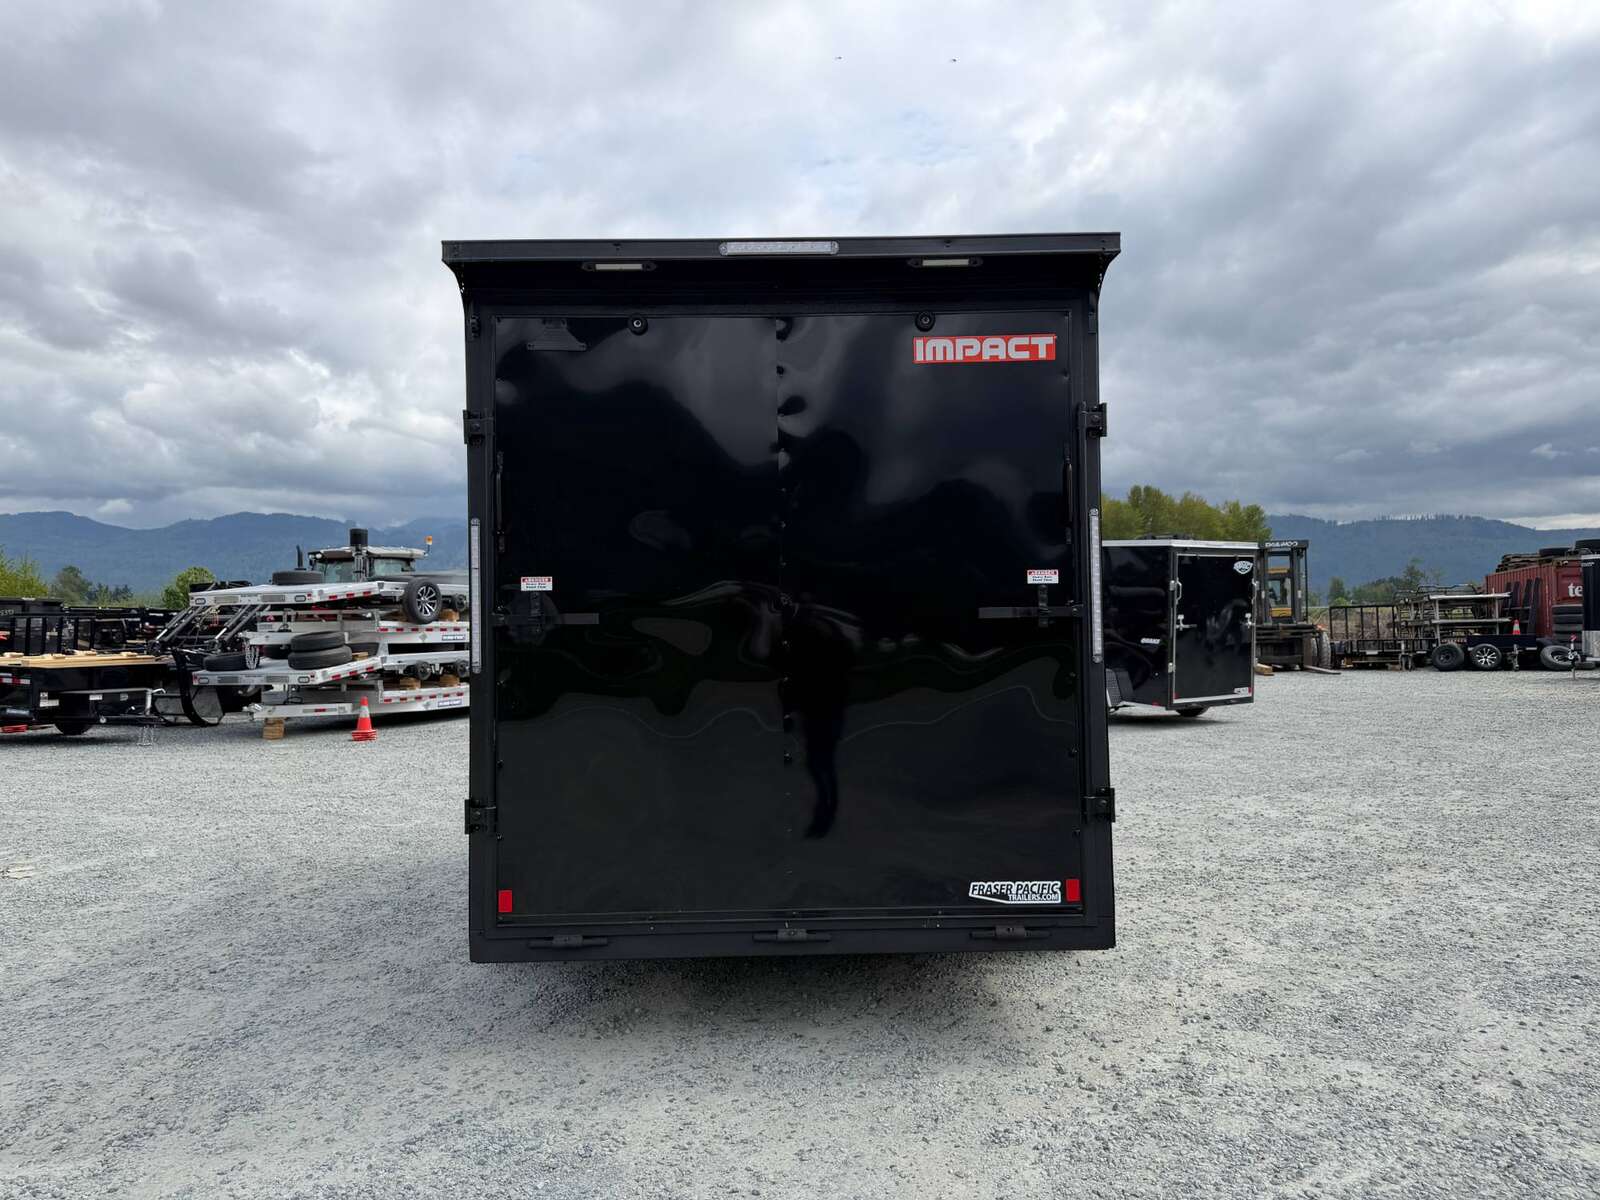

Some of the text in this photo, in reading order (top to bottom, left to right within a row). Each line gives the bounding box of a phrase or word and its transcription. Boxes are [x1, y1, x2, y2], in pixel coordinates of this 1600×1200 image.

[915, 336, 1054, 361] IMPACT
[971, 883, 1059, 895] FRASER PACIFIC
[1009, 893, 1058, 901] TRAILERS.COM
